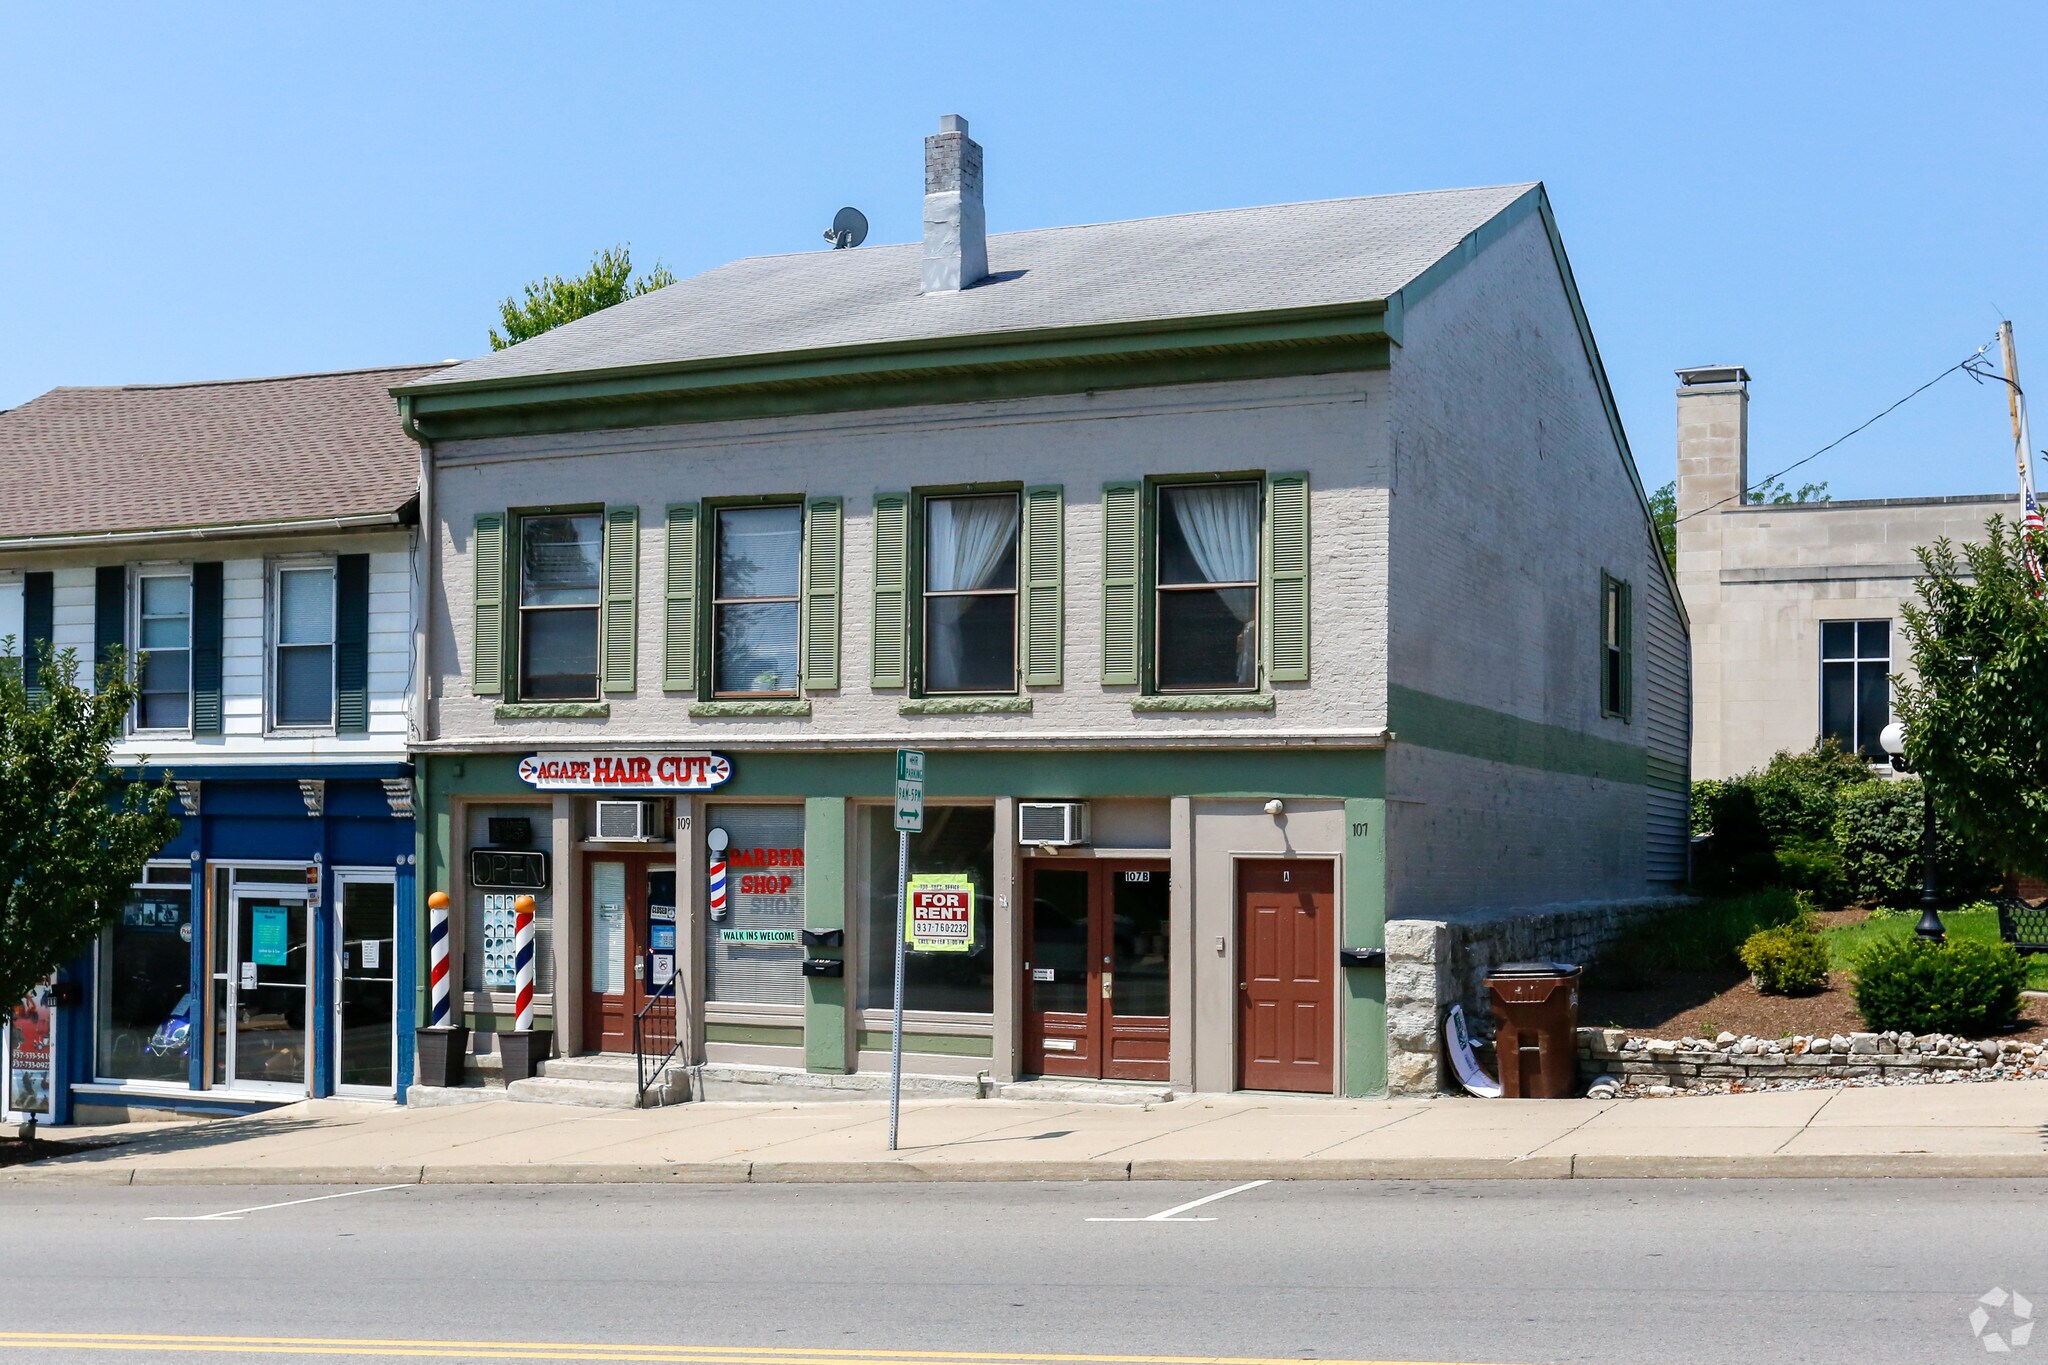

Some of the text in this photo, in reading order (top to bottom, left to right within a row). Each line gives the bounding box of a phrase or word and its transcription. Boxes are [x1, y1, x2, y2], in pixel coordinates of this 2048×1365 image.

[537, 756, 711, 783] AGAPE HAIR CUT
[906, 767, 923, 779] PARKING
[677, 817, 691, 830] 109
[1352, 822, 1368, 837] 107
[729, 848, 805, 867] BARBER
[476, 854, 542, 886] OPEN
[1125, 872, 1149, 881] 107B
[1284, 871, 1289, 881] A
[740, 875, 793, 894] SHOP
[921, 894, 959, 907] FOR
[652, 906, 668, 915] CLOSED
[915, 907, 966, 920] RENT
[916, 923, 967, 933] 937-760-2232
[723, 932, 795, 941] WALK INS WELCOME
[13, 1051, 50, 1060] 937-533-541
